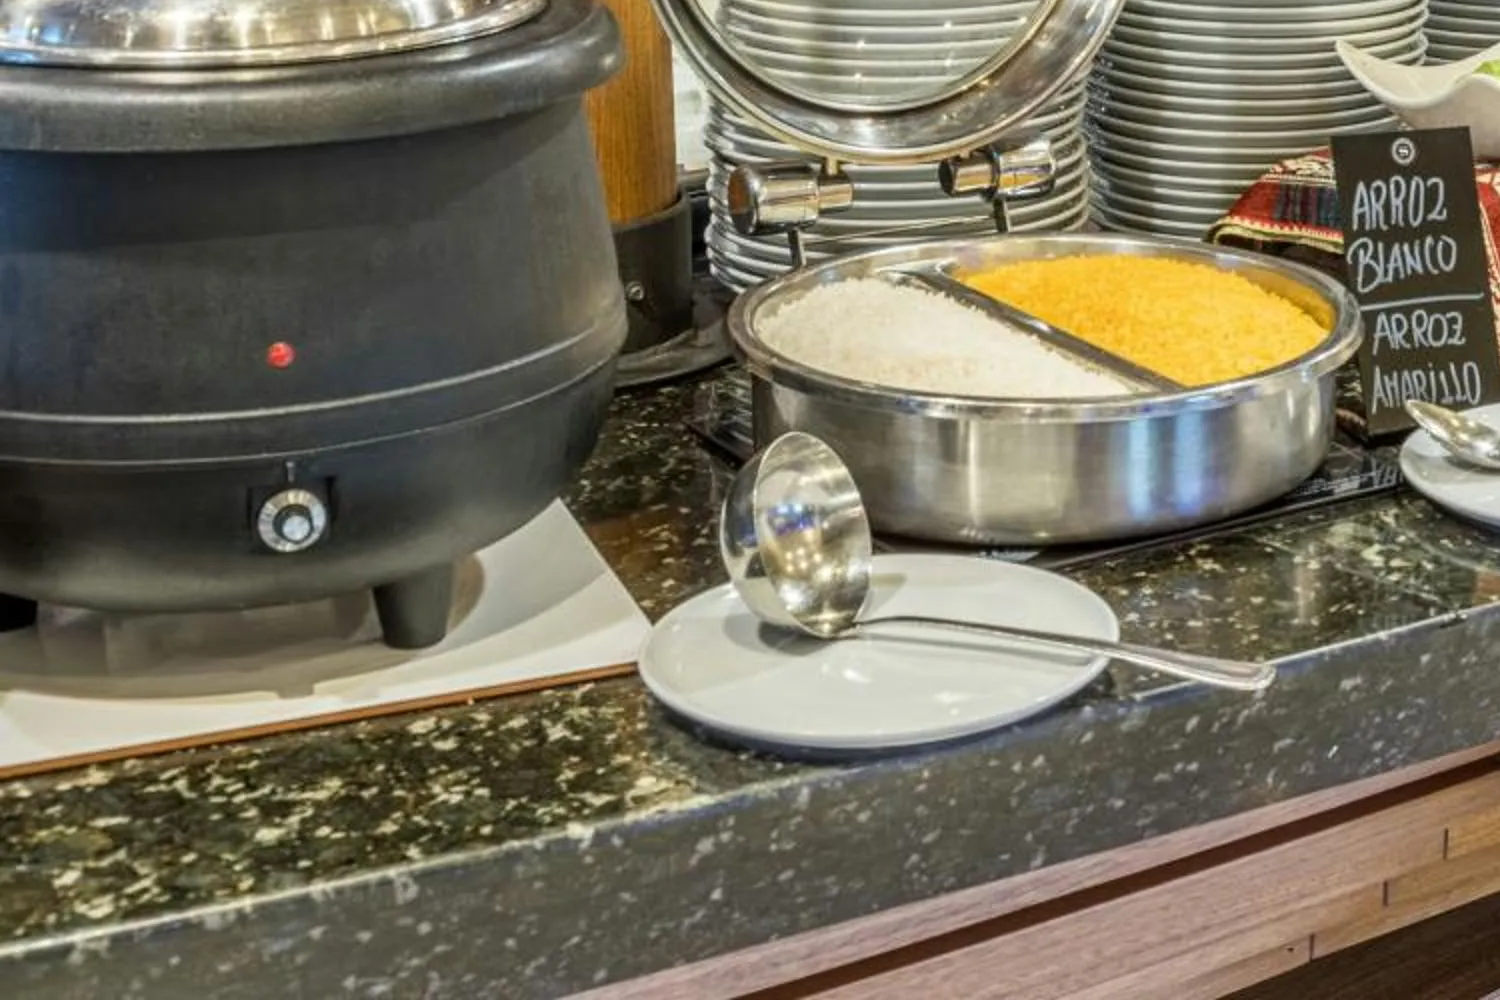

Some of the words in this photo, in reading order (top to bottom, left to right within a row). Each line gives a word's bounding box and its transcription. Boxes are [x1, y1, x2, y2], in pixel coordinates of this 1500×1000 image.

[1352, 176, 1448, 231] ARROZ
[1346, 234, 1457, 294] BLANCO
[1373, 310, 1467, 356] ARROZ
